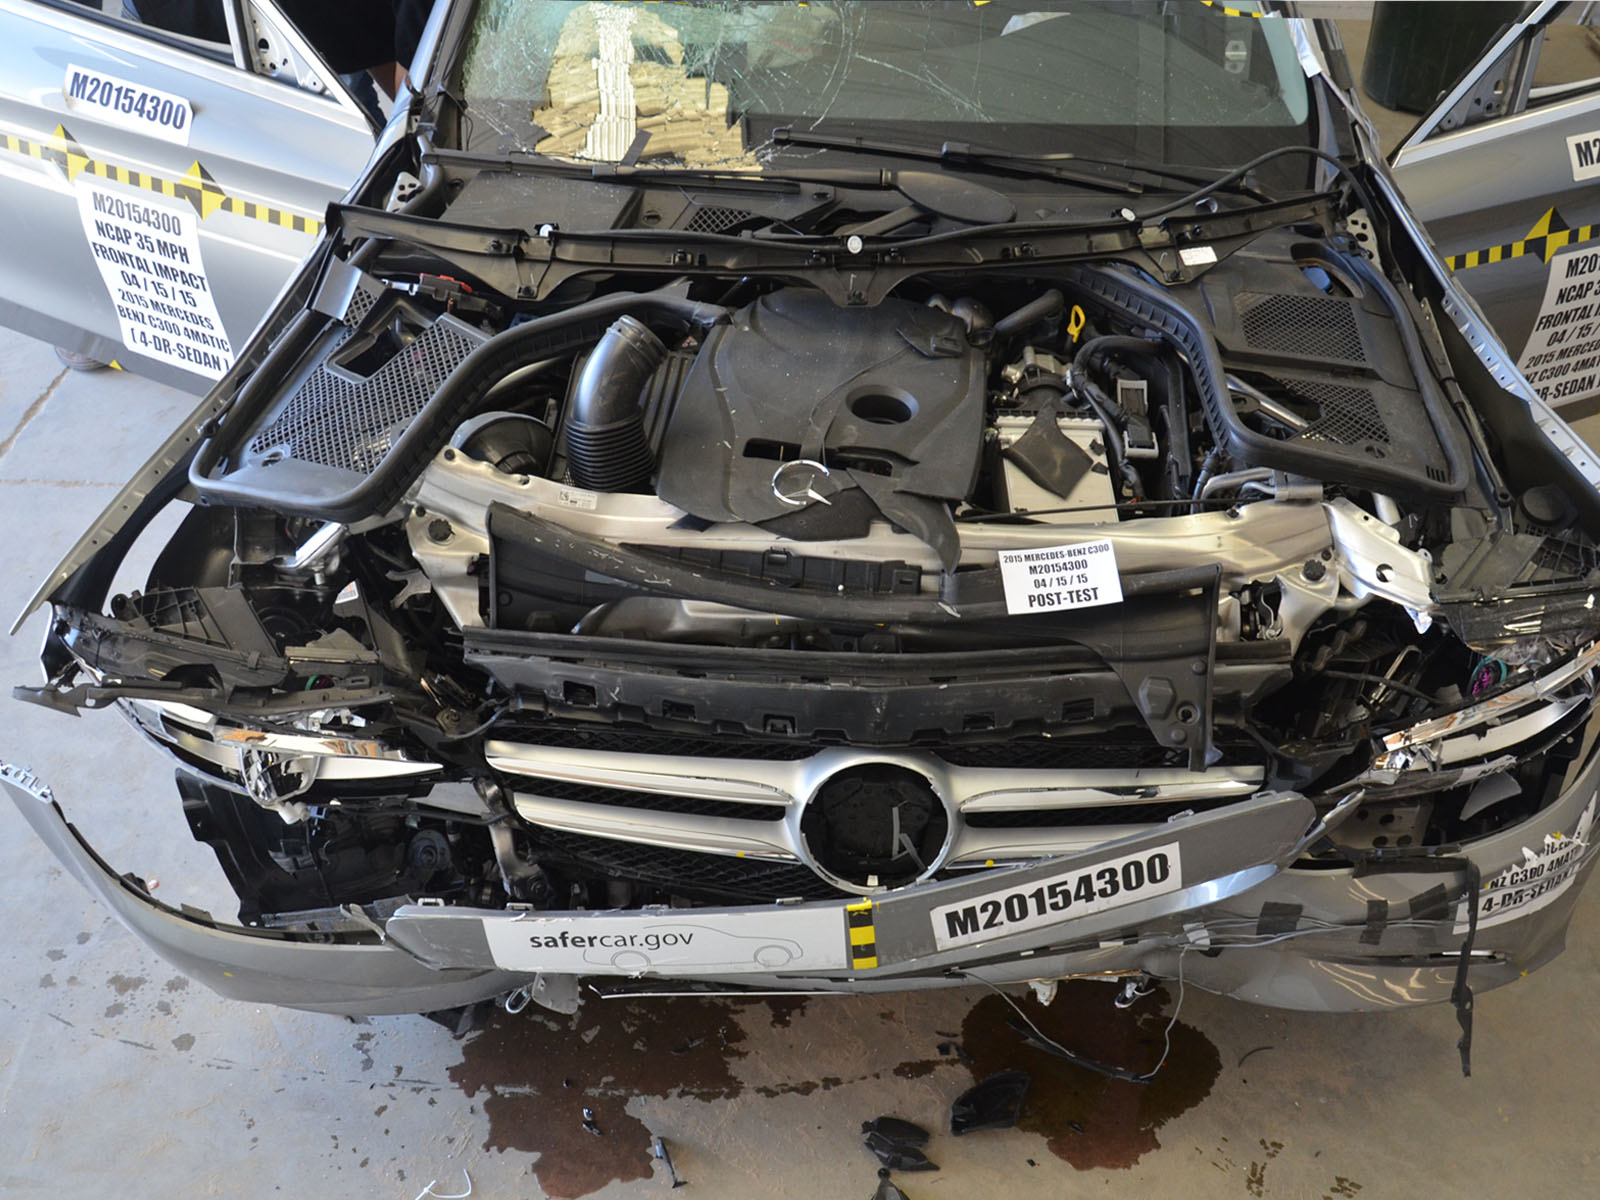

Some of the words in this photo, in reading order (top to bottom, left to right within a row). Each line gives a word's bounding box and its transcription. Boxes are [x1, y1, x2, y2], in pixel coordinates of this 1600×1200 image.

[70, 72, 186, 130] M20154300
[92, 191, 181, 236] M20154300
[95, 219, 132, 245] NCAP
[134, 232, 155, 253] 35
[156, 239, 190, 264] MPH
[91, 241, 153, 275] FRONTAL
[152, 261, 207, 292] IMPACT
[1565, 253, 1600, 278] M20
[1555, 281, 1594, 305] NCAP
[118, 288, 149, 309] 2015
[149, 299, 214, 330] MERCEDES
[1535, 303, 1594, 332] FRONTAL
[117, 304, 147, 325] BENZ
[148, 315, 181, 336] C300
[183, 327, 230, 352] 4MATIC
[1525, 350, 1557, 369] 2015
[1538, 363, 1571, 382] C300
[1003, 554, 1023, 563] 2015
[1024, 547, 1086, 562] MERCEDES-BENZ
[1088, 543, 1110, 555] C300
[1029, 559, 1088, 575] M20154300
[1028, 587, 1099, 608] POST-TEST
[1510, 863, 1544, 886] C300
[945, 853, 1170, 938] M20154300
[530, 931, 693, 950] safercar.gov
